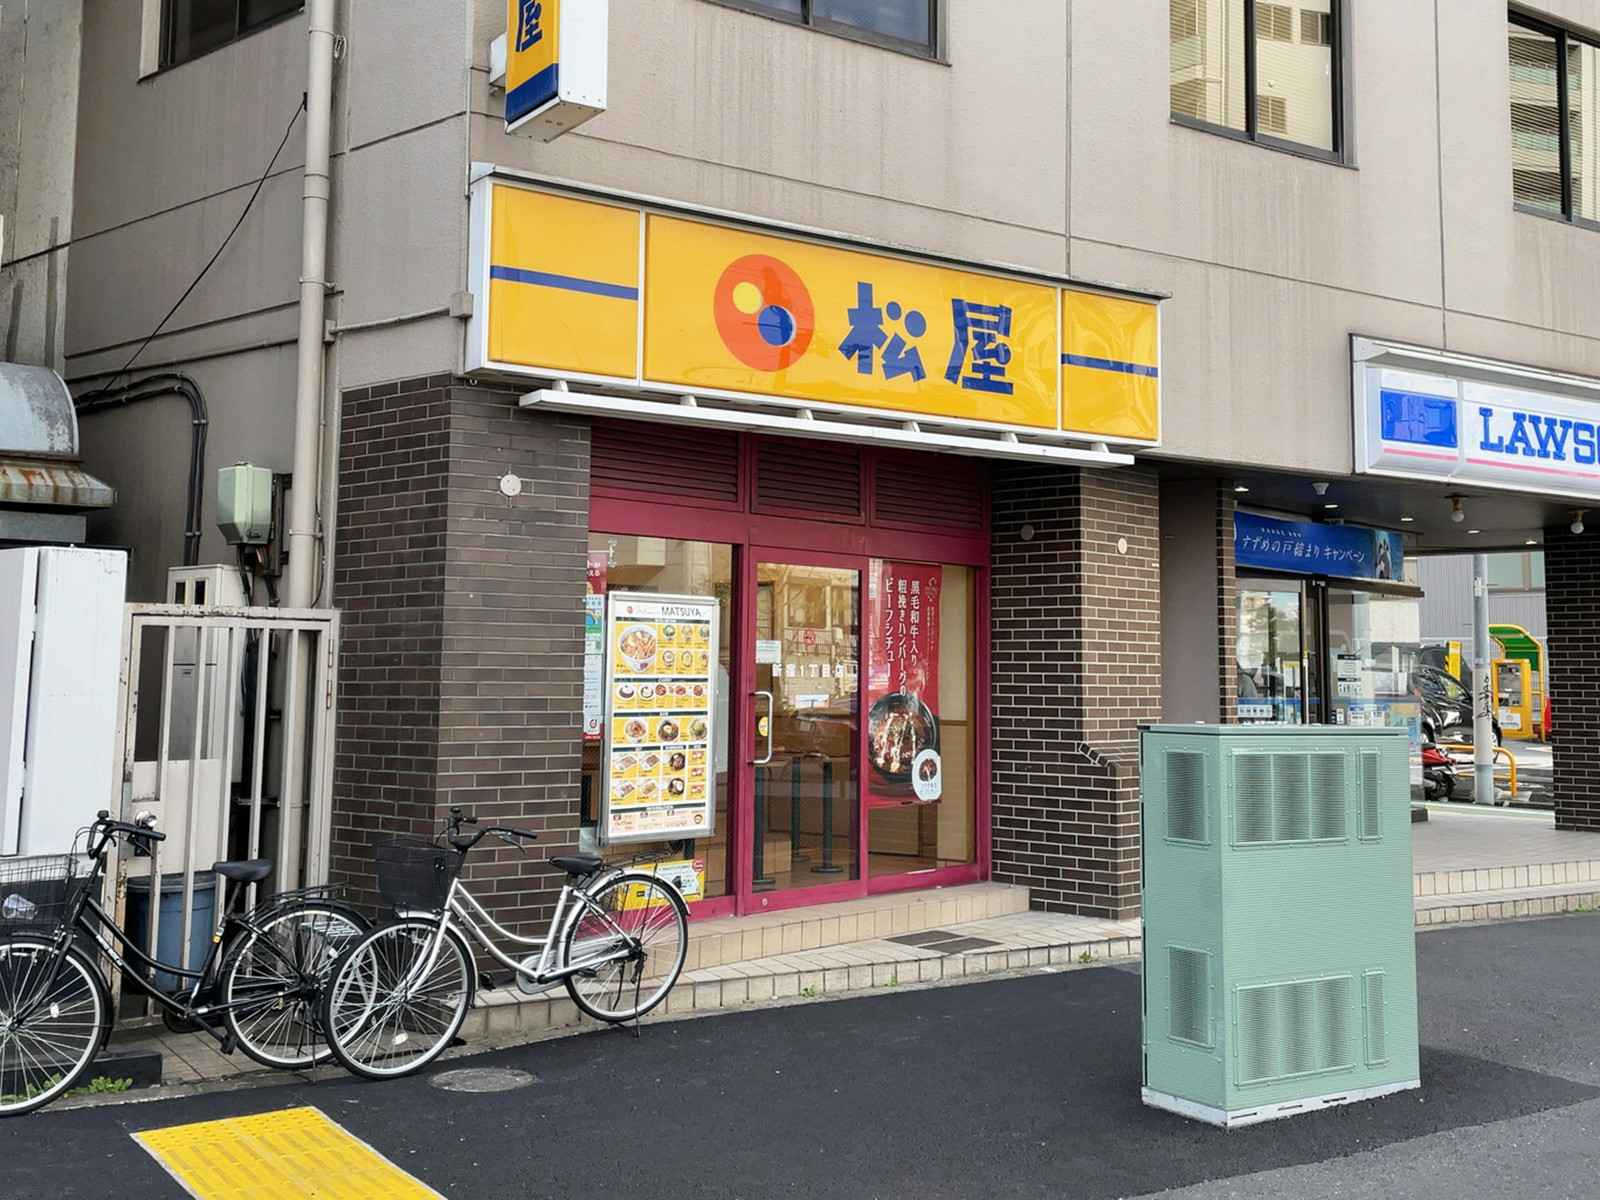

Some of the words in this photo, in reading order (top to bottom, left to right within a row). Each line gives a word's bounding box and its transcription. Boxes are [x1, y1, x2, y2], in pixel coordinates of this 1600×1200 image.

[838, 281, 1014, 395] 松屋
[1479, 407, 1600, 465] LAWS
[1324, 546, 1365, 563] キャンペーン
[661, 606, 702, 617] MATSUYA
[885, 578, 895, 678] ビーフシチュー
[898, 579, 908, 697] 粗挽きハンバーグの
[910, 581, 920, 667] 黒毛和牛入り
